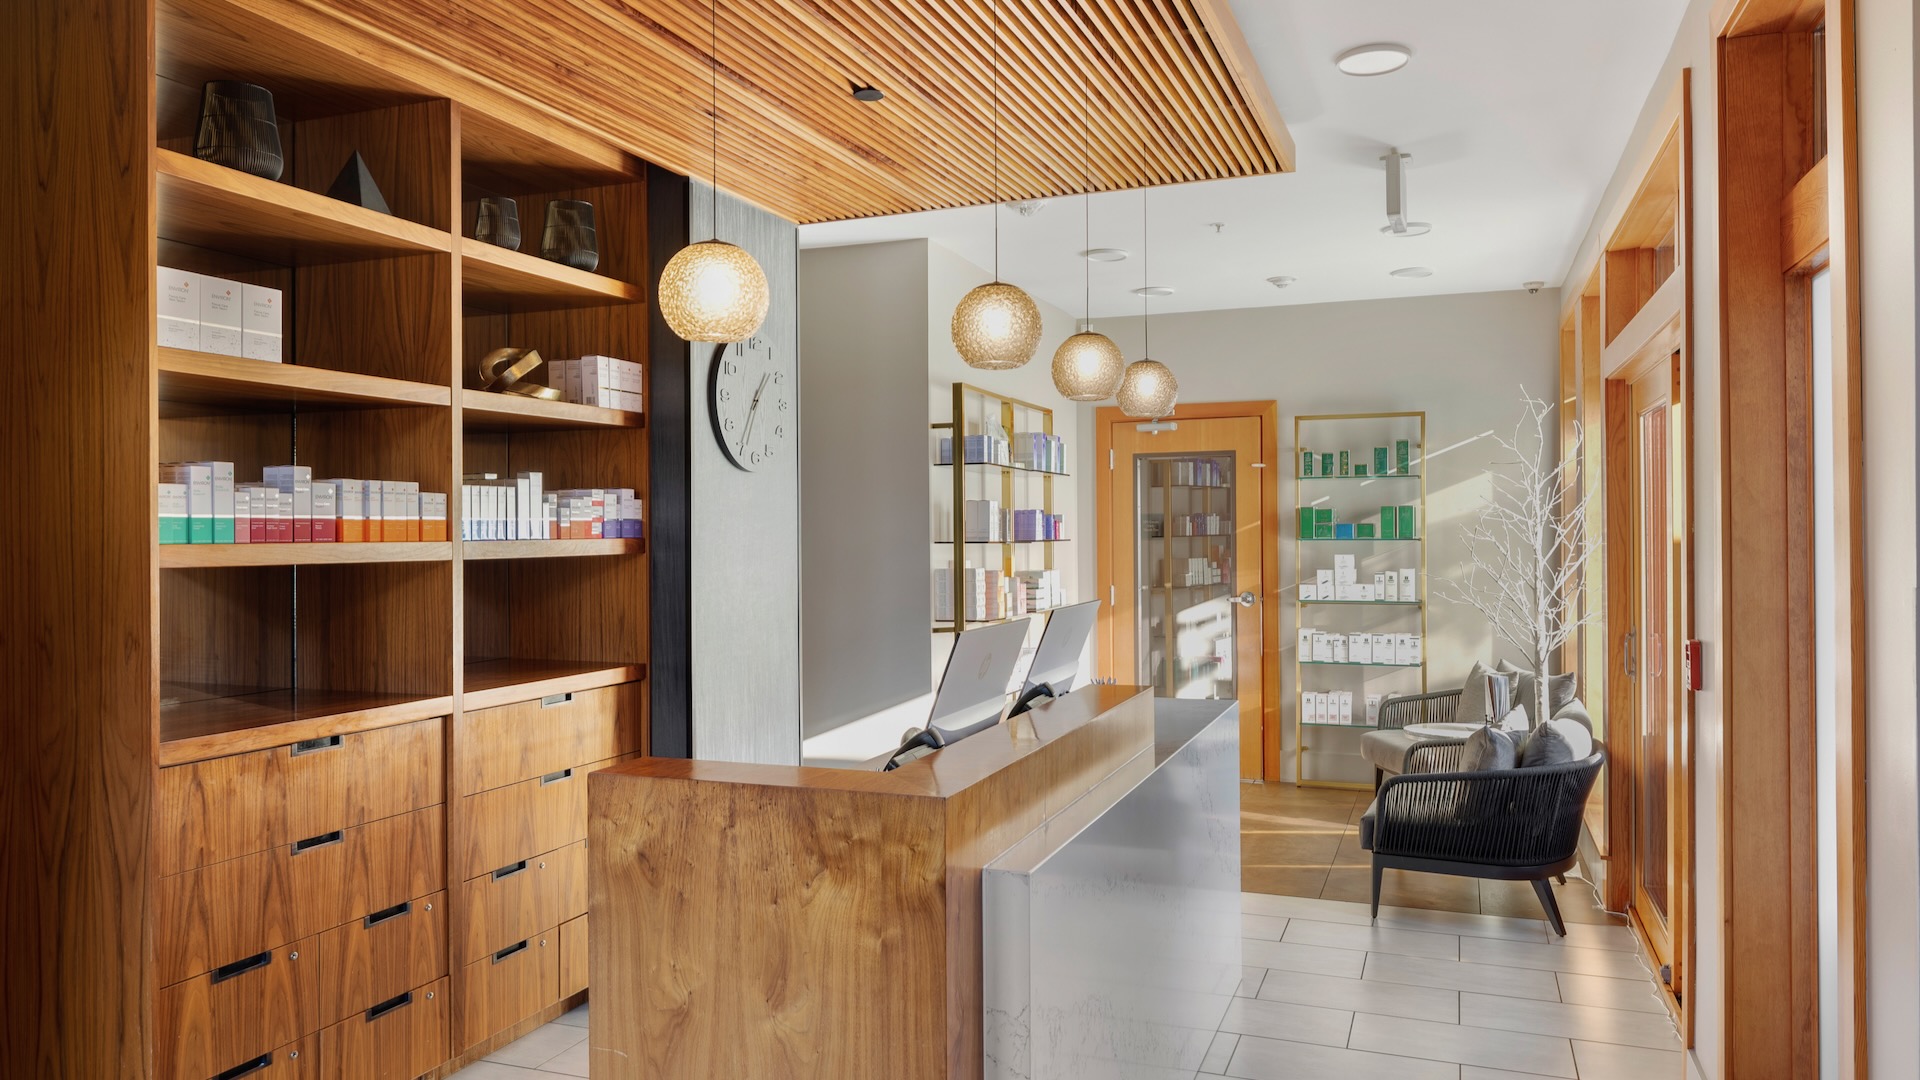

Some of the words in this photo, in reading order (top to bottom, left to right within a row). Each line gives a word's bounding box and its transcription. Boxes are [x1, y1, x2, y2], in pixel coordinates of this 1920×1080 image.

[212, 294, 231, 302] ENVIRON
[748, 336, 762, 351] 12
[724, 360, 737, 376] 10
[736, 442, 744, 456] 7
